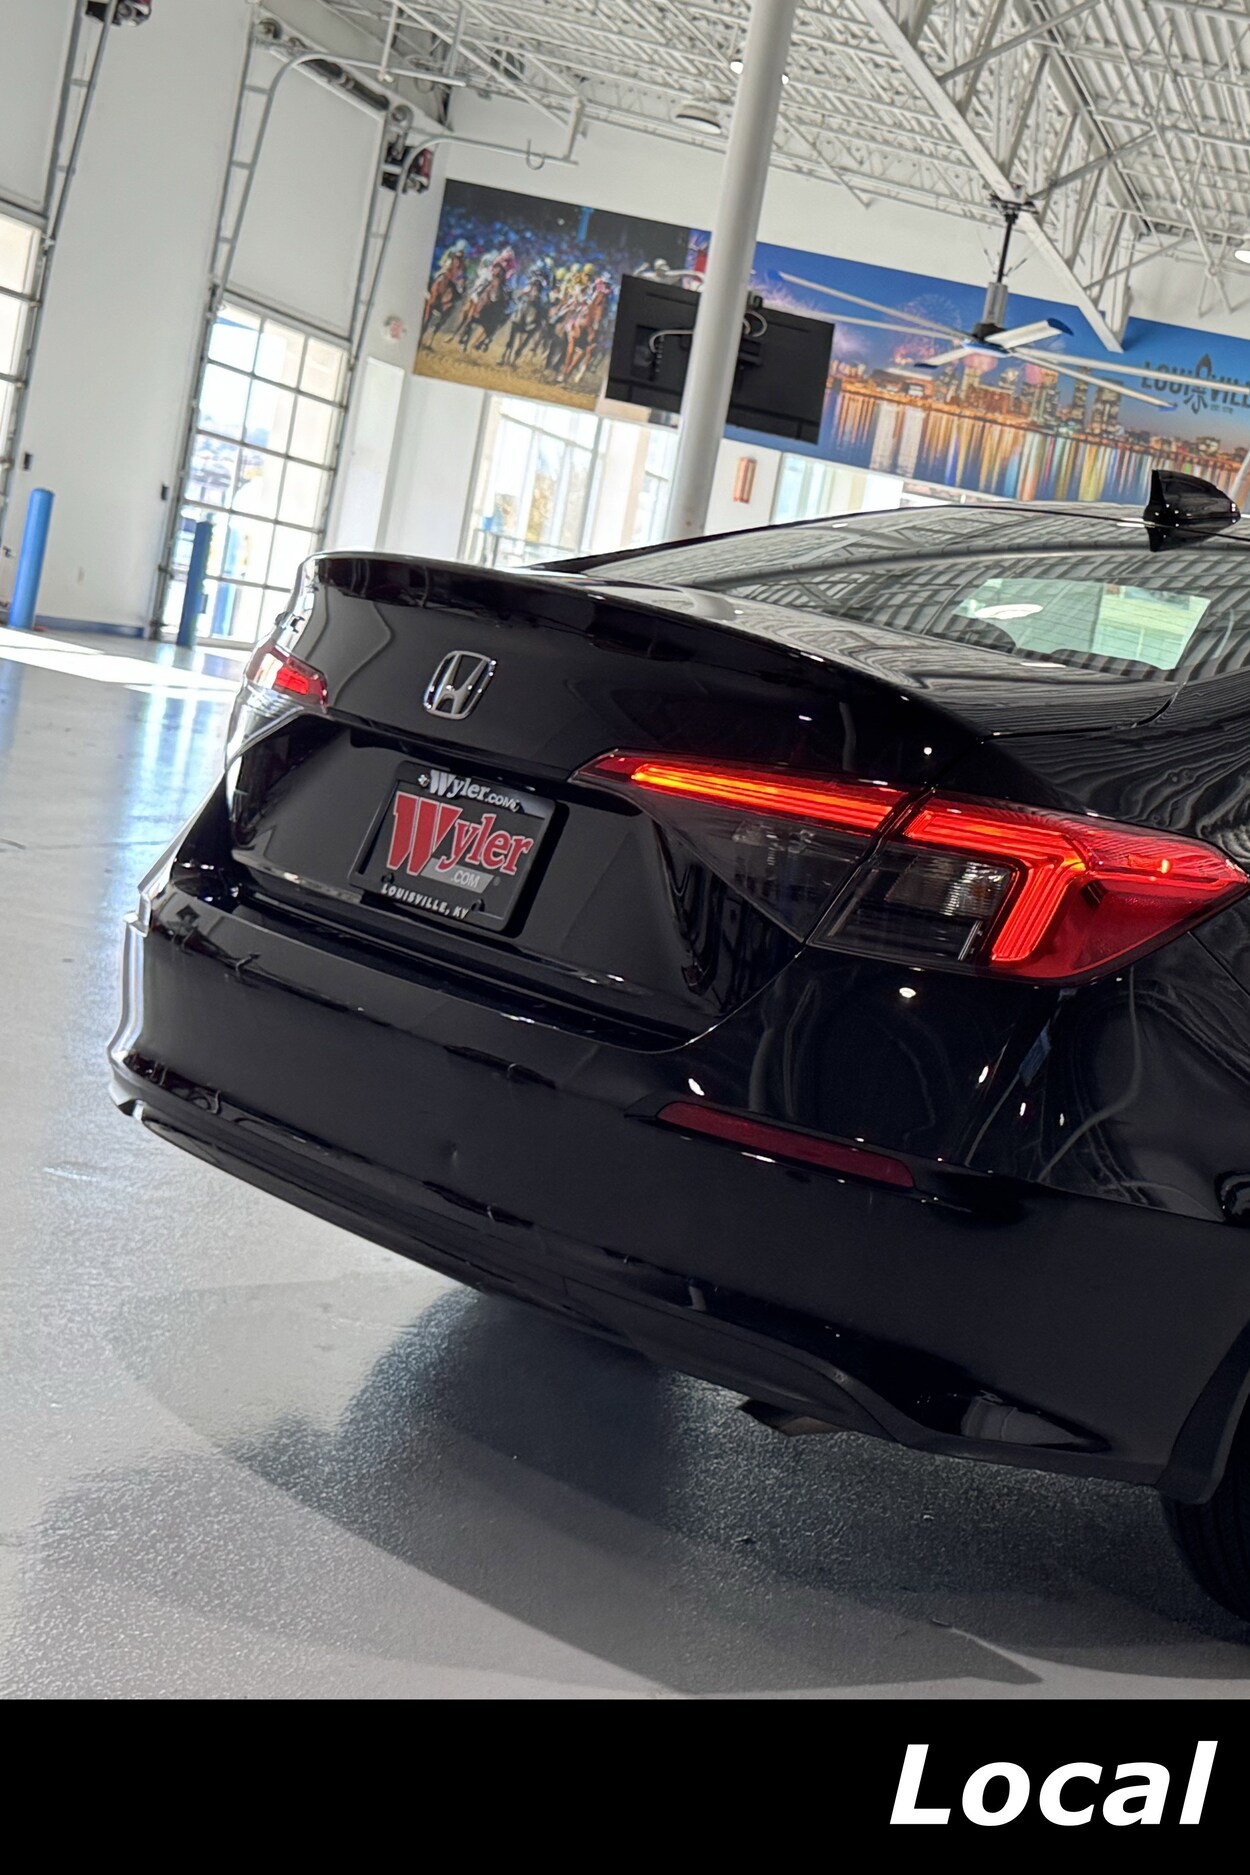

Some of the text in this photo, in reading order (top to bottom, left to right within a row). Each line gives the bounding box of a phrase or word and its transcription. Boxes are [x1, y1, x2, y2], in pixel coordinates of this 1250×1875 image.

[386, 791, 534, 876] Wyler
[380, 883, 470, 919] LOUISVILLE, KY
